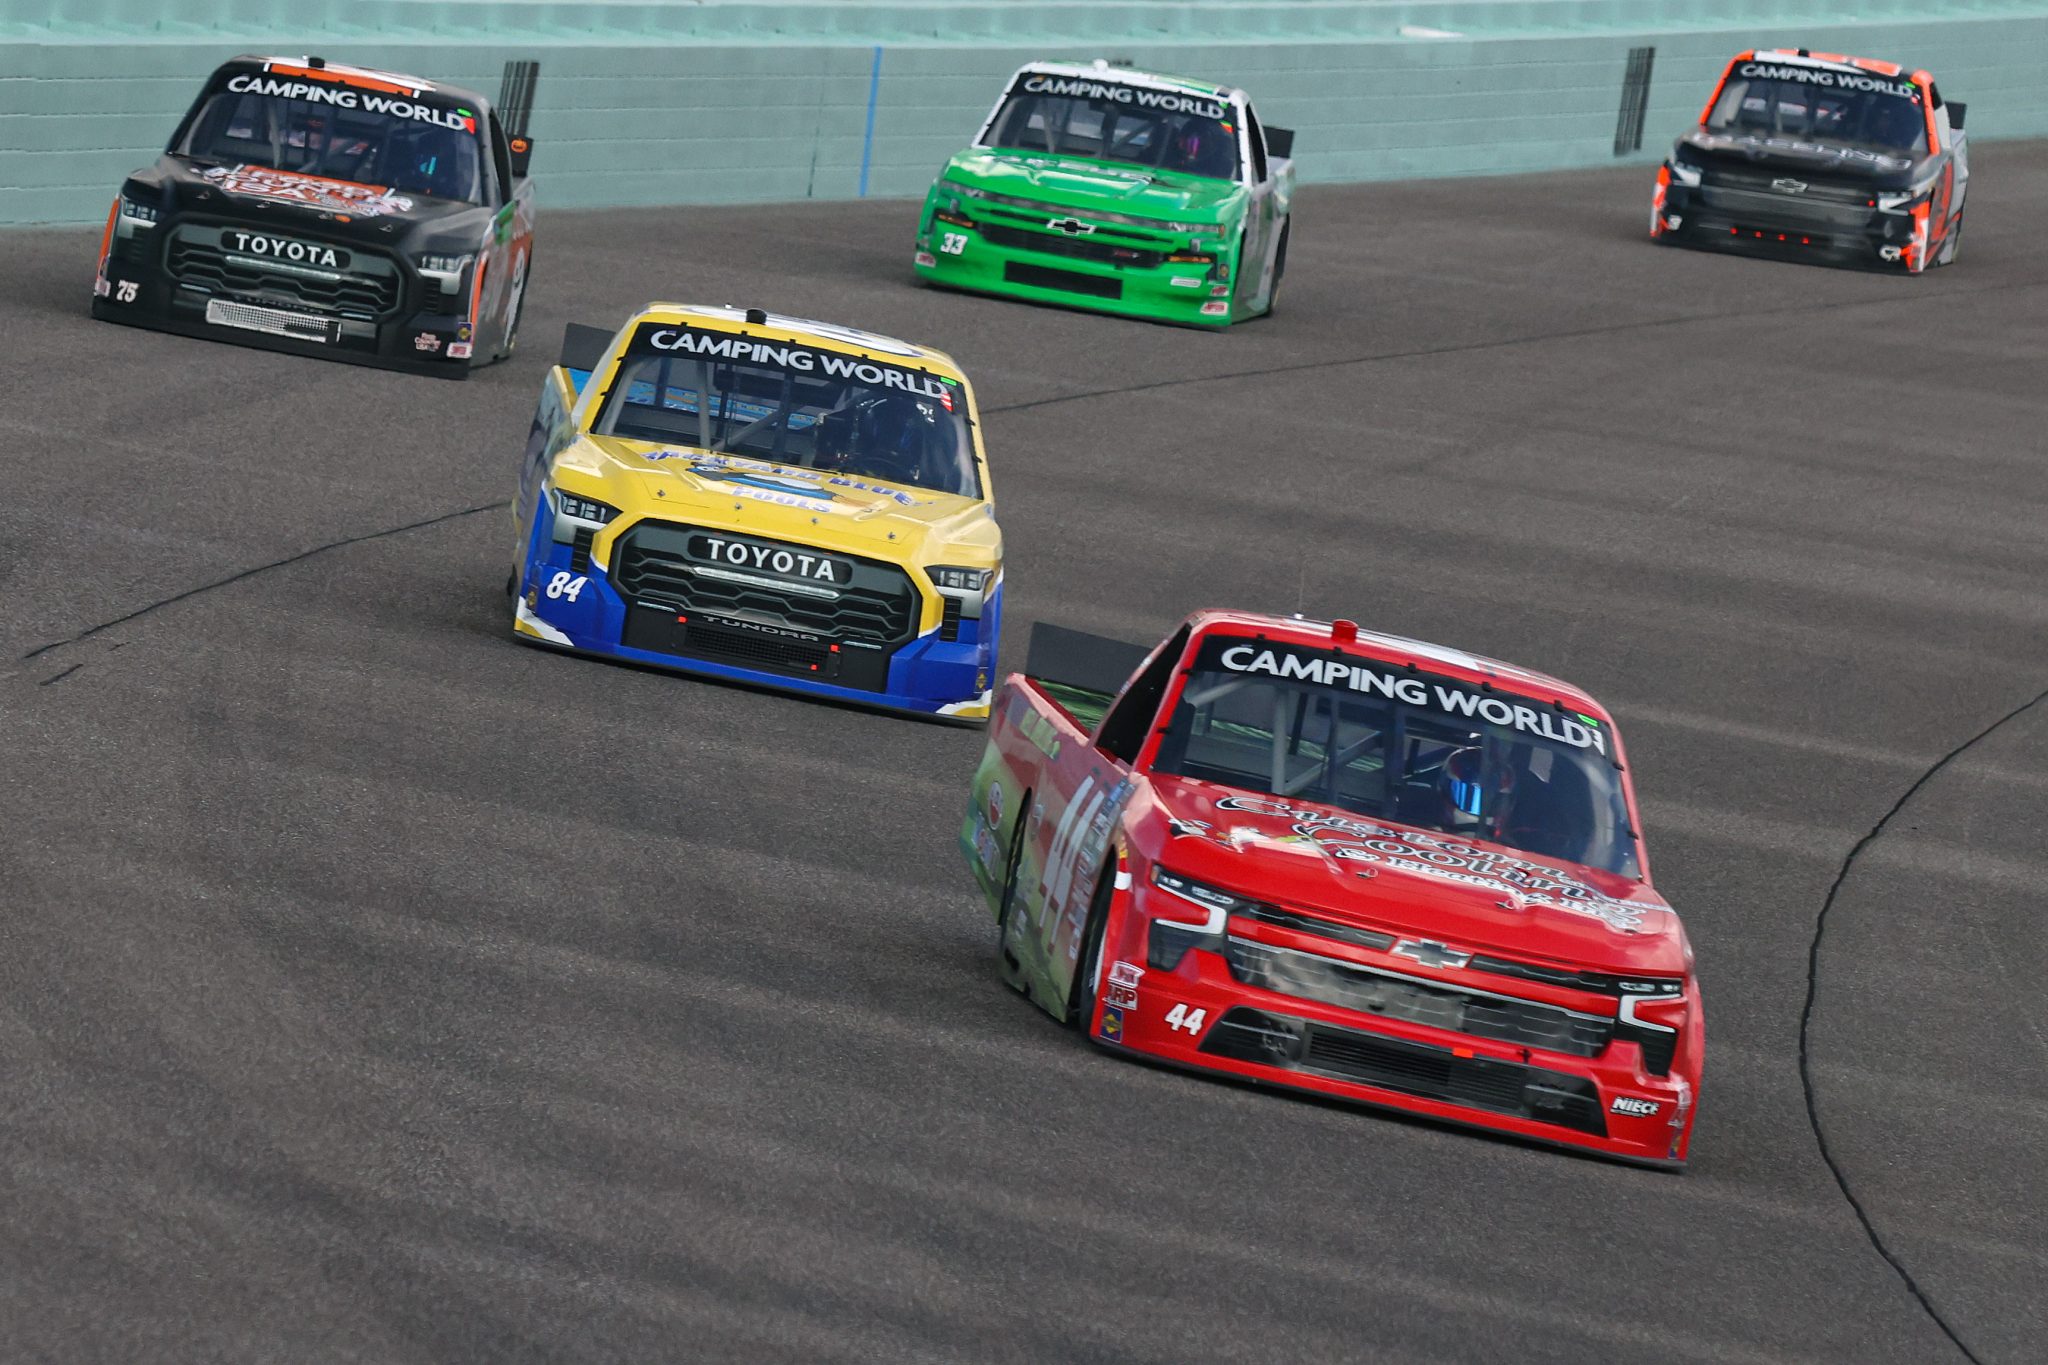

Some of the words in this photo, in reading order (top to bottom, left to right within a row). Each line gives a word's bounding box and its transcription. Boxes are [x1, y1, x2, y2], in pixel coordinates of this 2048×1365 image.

[1741, 64, 1833, 86] CAMPING
[1837, 76, 1913, 97] WORLD
[228, 76, 357, 108] CAMPING
[362, 94, 466, 130] WORLD
[1024, 76, 1133, 103] CAMPING
[1136, 91, 1225, 120] WORLD
[235, 233, 337, 267] TOYOTA
[940, 232, 968, 255] 33
[116, 280, 140, 302] 75
[651, 330, 813, 370] CAMPING
[818, 355, 948, 398] WORLD
[733, 486, 832, 513] POOLS
[707, 538, 835, 582] TOYOTA
[546, 571, 588, 602] 84
[703, 614, 819, 642] TUNDRA
[1222, 647, 1427, 705] CAMPING
[1434, 685, 1593, 748] WORLD
[1216, 796, 1572, 880] Custom
[1292, 822, 1647, 930] Cooling
[1164, 1003, 1207, 1036] 44
